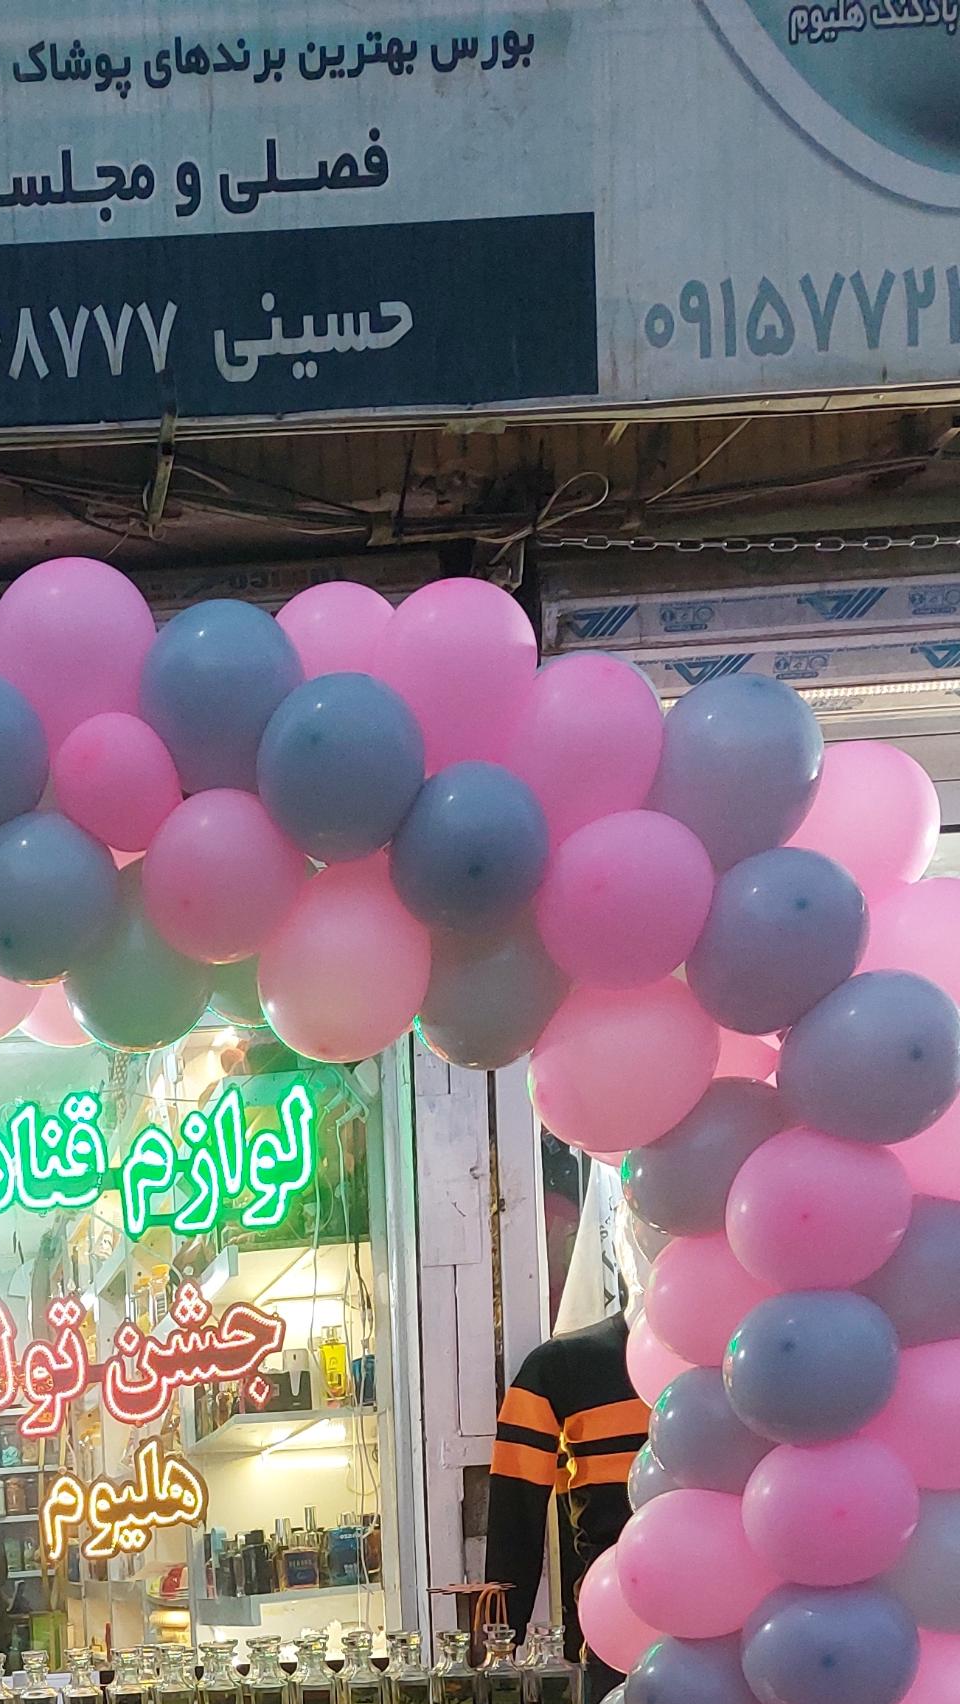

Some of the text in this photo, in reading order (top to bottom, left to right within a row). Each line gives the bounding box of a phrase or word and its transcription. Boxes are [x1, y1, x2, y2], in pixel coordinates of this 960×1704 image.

[13, 39, 132, 99] پوشاک
[144, 36, 286, 89] برندهای
[298, 30, 418, 81] بهترین
[430, 29, 535, 73] بورس
[175, 160, 202, 217] و
[219, 127, 390, 215] فصلی
[213, 291, 414, 383] حسینی
[122, 1082, 317, 1238] لوازم
[102, 1281, 287, 1425] جشن
[43, 1437, 209, 1561] هلیوم
